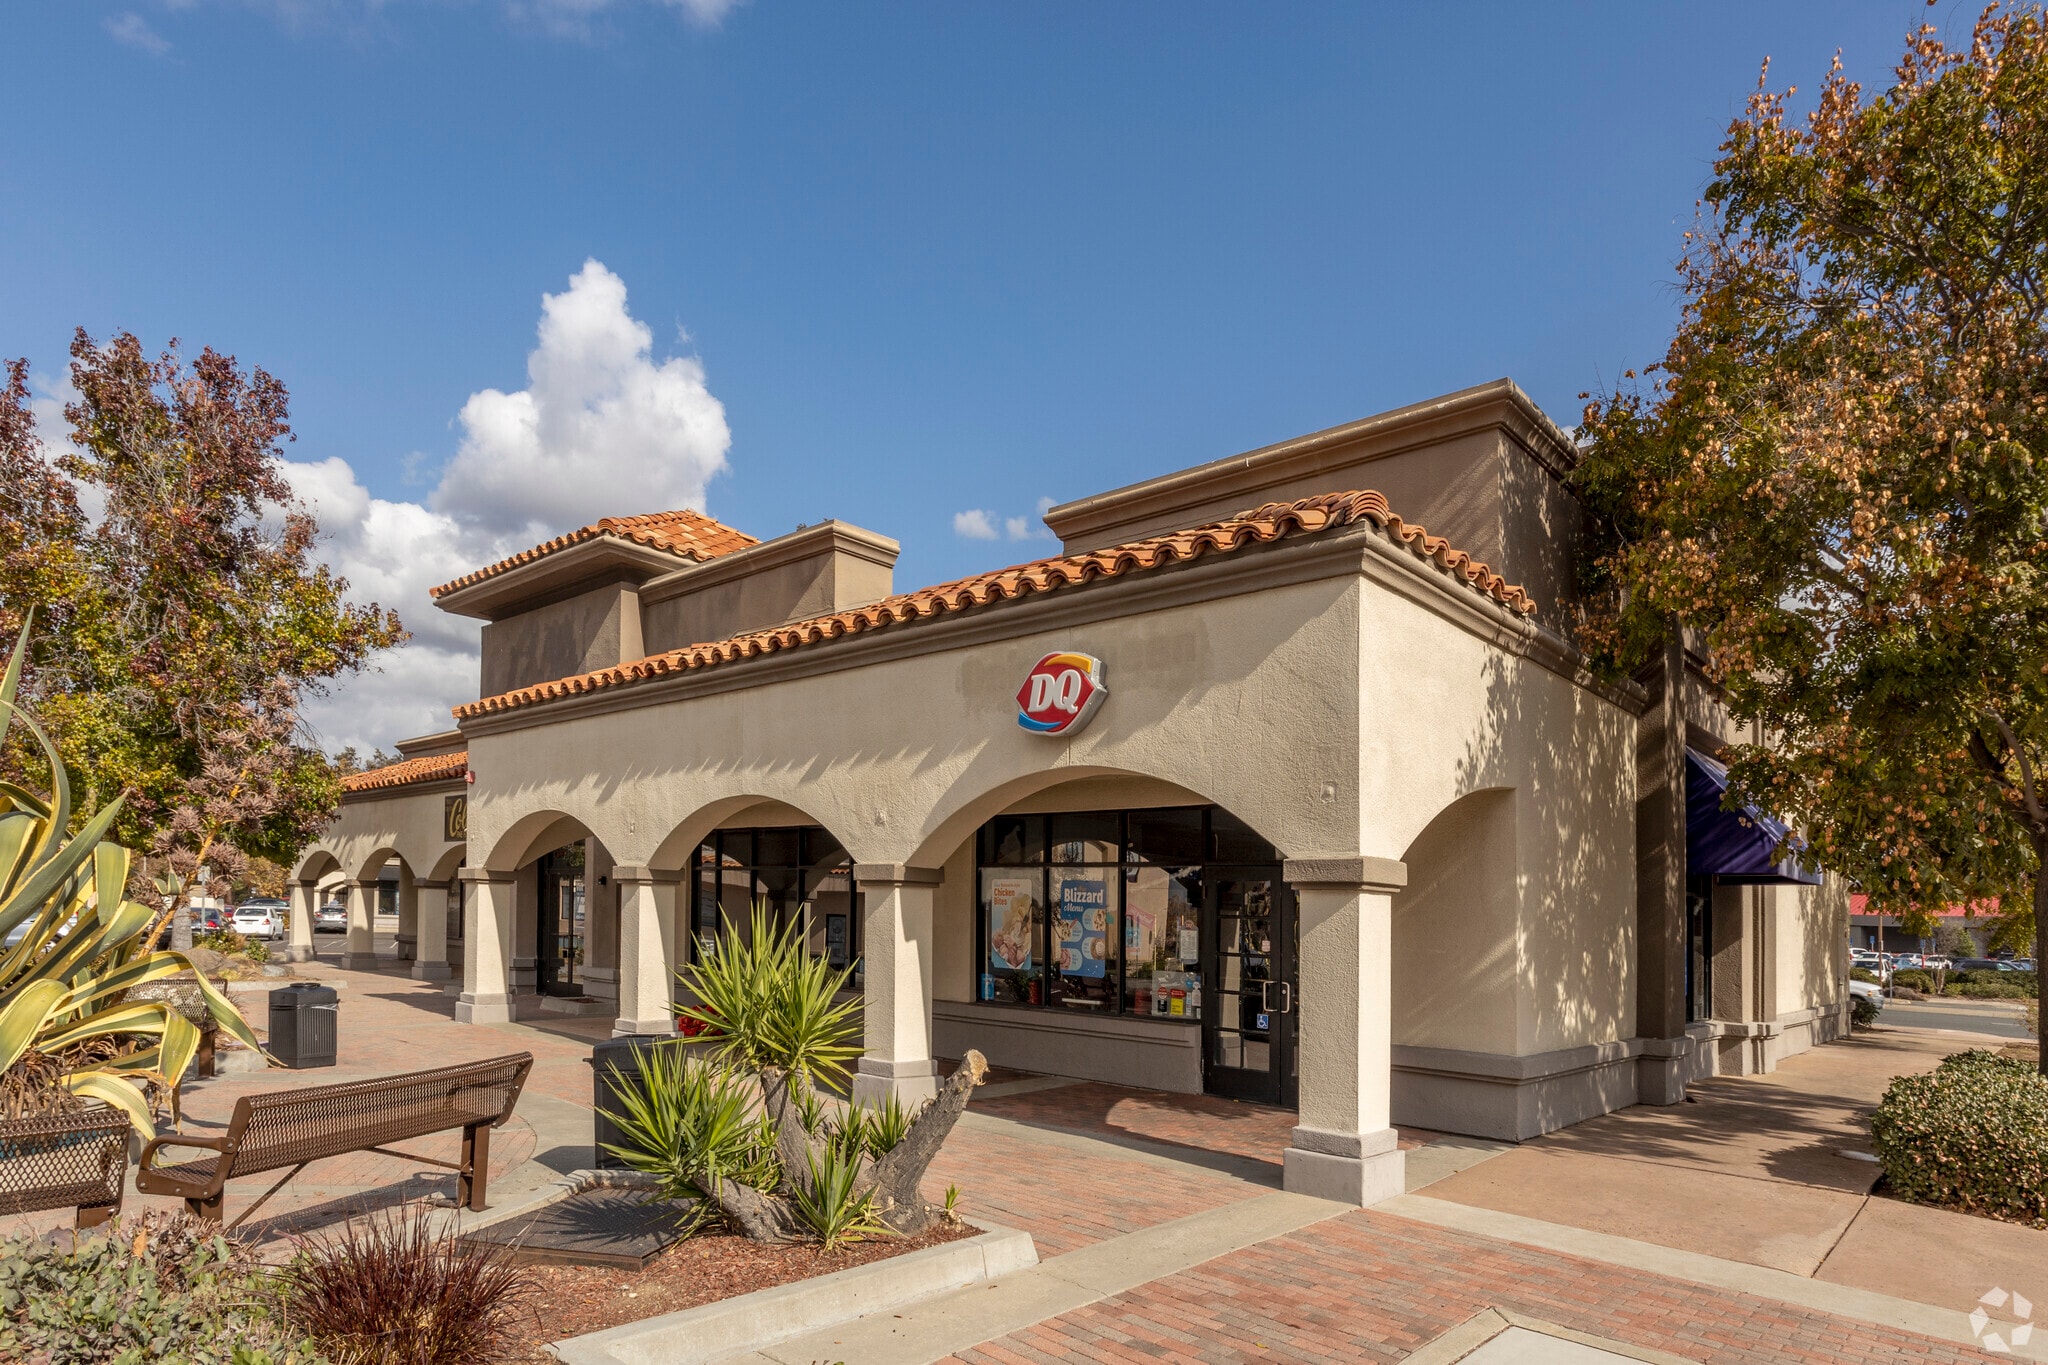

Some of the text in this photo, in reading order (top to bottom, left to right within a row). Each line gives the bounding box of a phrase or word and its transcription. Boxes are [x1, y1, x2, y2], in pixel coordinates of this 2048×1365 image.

[1027, 669, 1082, 714] DQ
[994, 888, 1015, 897] Chicken
[1064, 887, 1104, 903] Blizzard
[1064, 903, 1083, 911] Menu
